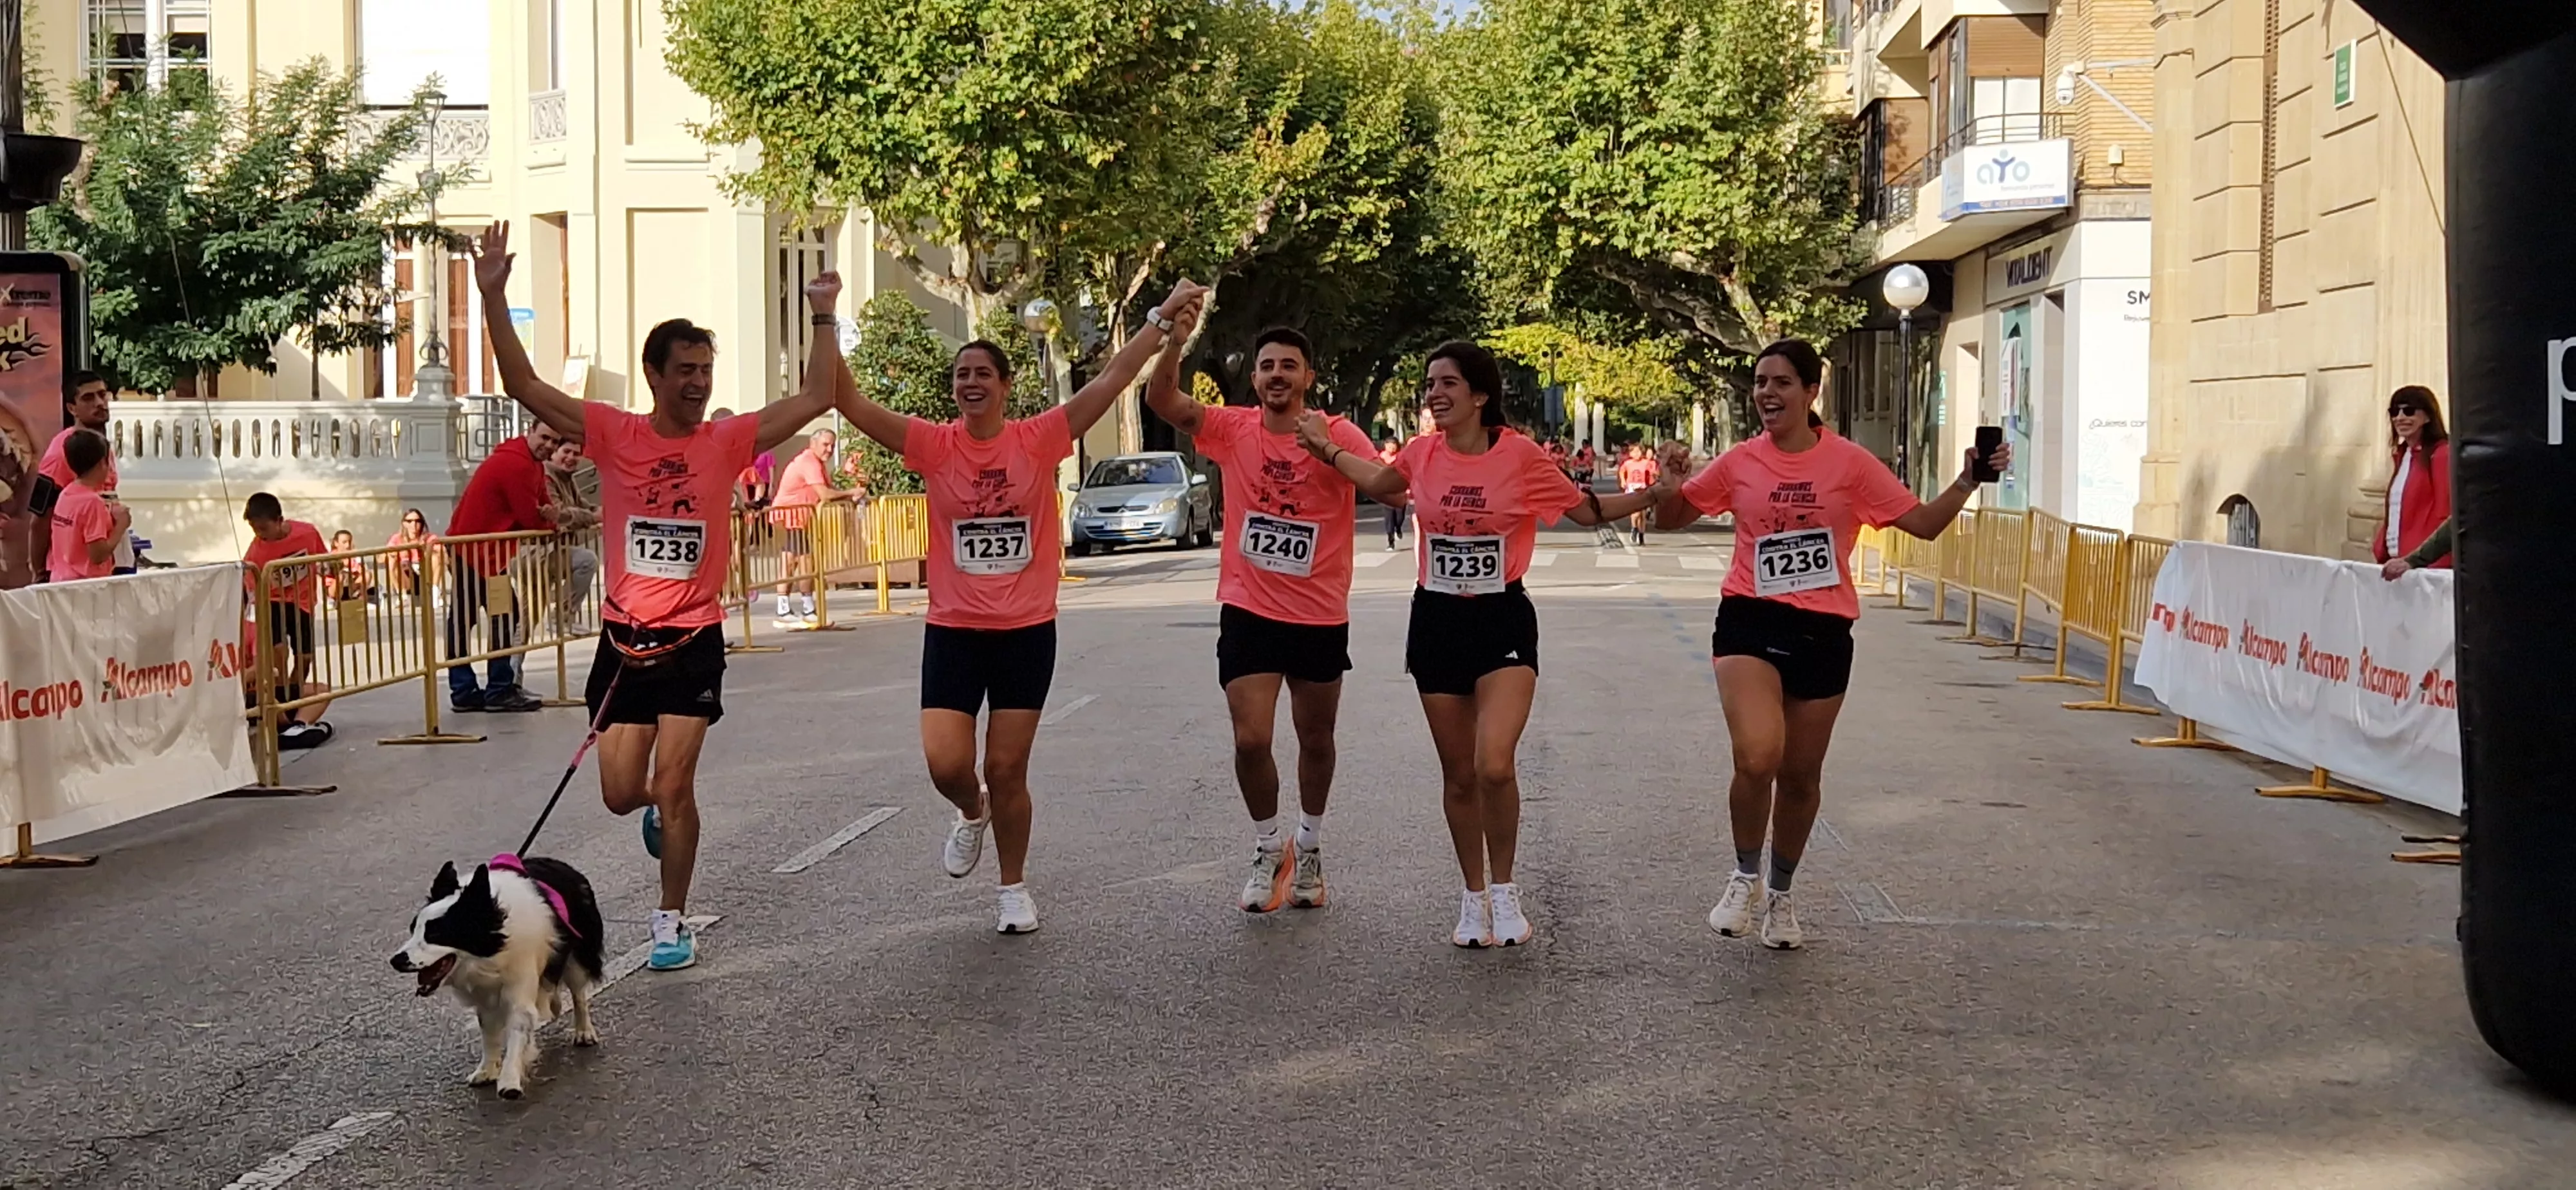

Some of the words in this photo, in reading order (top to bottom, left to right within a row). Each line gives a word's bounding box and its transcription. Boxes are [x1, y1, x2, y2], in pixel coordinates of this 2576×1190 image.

[635, 538, 698, 562] 1238
[963, 536, 1023, 558] 1237
[1249, 533, 1307, 560] 1240
[1435, 555, 1497, 578] 1239
[1762, 547, 1828, 577] 1236
[2179, 604, 2229, 653] Alcampo
[2239, 618, 2287, 669] Alcampo
[2297, 632, 2349, 686] Alcampo
[2356, 646, 2411, 706] Alcampo
[101, 657, 193, 703] Alcampo
